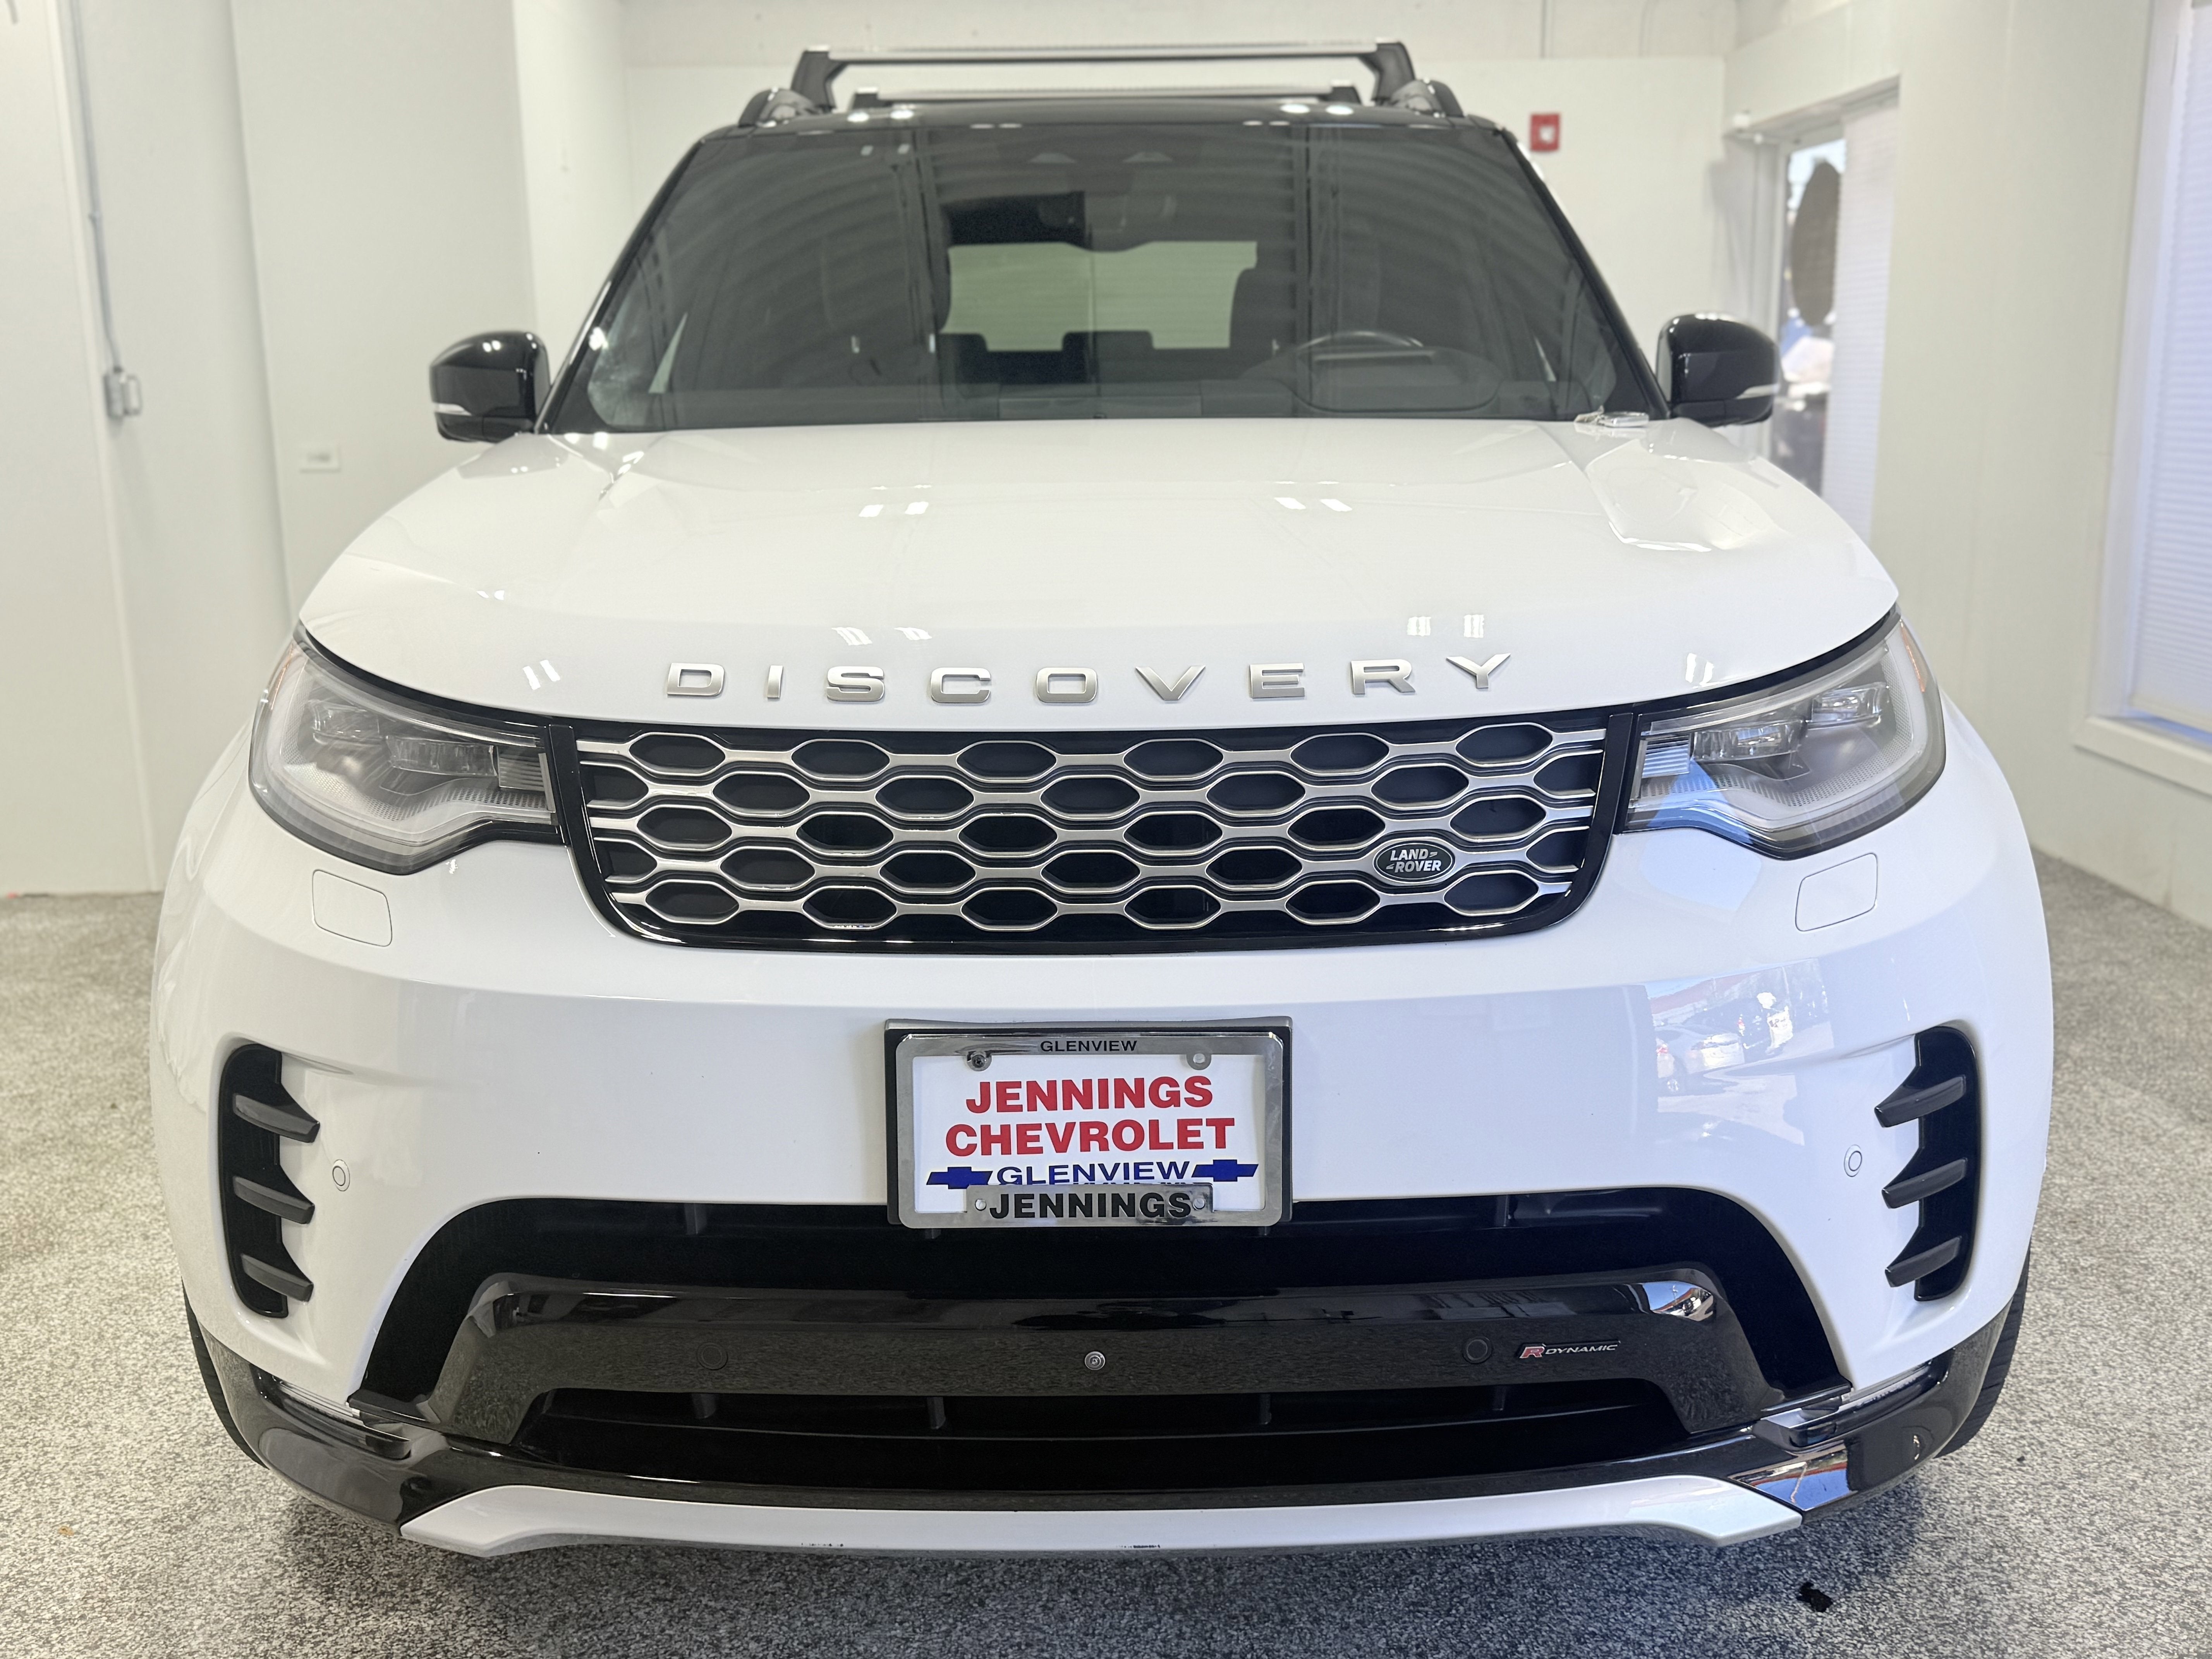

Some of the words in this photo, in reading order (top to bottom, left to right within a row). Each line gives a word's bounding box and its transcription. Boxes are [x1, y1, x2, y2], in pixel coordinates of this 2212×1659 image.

[667, 653, 1511, 704] DISCOVERY
[1390, 848, 1429, 861] LAND
[1395, 860, 1441, 873] ROVER
[1040, 1040, 1137, 1052] GLENVIEW
[966, 1076, 1213, 1113] JENNINGS
[946, 1118, 1235, 1156] CHEVROLET
[997, 1161, 1190, 1184] GLENVIEW
[989, 1192, 1191, 1219] JENNINGS
[1546, 1345, 1618, 1354] DYNAMIC
